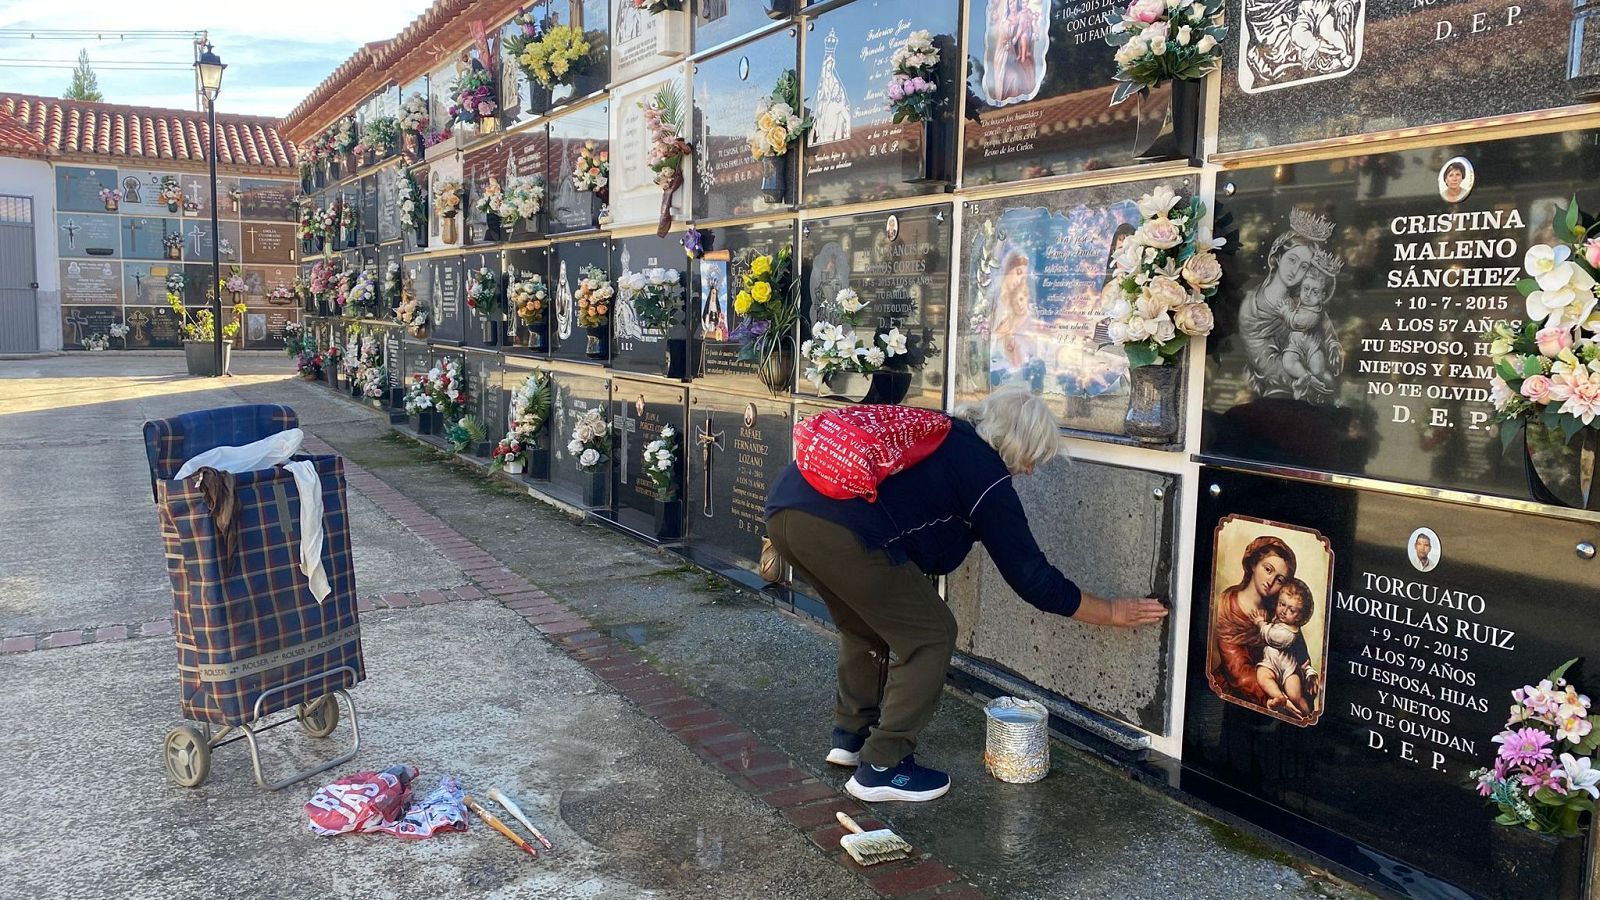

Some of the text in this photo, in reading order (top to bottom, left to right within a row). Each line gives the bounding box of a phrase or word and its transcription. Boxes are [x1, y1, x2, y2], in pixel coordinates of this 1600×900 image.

[1067, 17, 1086, 32] CON
[1435, 6, 1523, 41] D. E. P.
[1075, 32, 1087, 44] TU
[970, 204, 980, 214] 15
[1390, 208, 1525, 235] CRISTINA
[1393, 238, 1517, 262] MALENO
[1387, 266, 1521, 288] SÁNCHEZ
[1409, 297, 1427, 310] 10
[1442, 297, 1451, 310] 7
[1466, 296, 1508, 310] 2015
[1380, 319, 1392, 331] A
[1397, 319, 1434, 332] LOS
[1439, 319, 1458, 332] 57
[1362, 339, 1385, 352] TU
[1389, 340, 1468, 358] ESPOSO,
[1359, 360, 1427, 376] NIETOS
[1432, 364, 1445, 377] Y
[1368, 382, 1488, 402] NO TE OLVID
[1392, 405, 1490, 431] D. E. P.
[740, 427, 762, 440] RAFAEL
[739, 453, 763, 468] LOZANO
[1363, 572, 1485, 614] TORCUATO
[1336, 591, 1515, 650] MORILLAS RUIZ
[242, 658, 269, 671] ROLSER
[282, 648, 306, 659] ROLSER
[1404, 634, 1420, 649] 07
[1434, 641, 1468, 662] 2015
[1361, 645, 1476, 686] A LOS 79 AÑOS
[1349, 661, 1489, 713] TU ESPOSA, HIJAS
[1378, 690, 1450, 724] Y NIETOS
[1350, 703, 1479, 756] NO TE OLVIDAN.
[1368, 730, 1447, 773] D. E. P.
